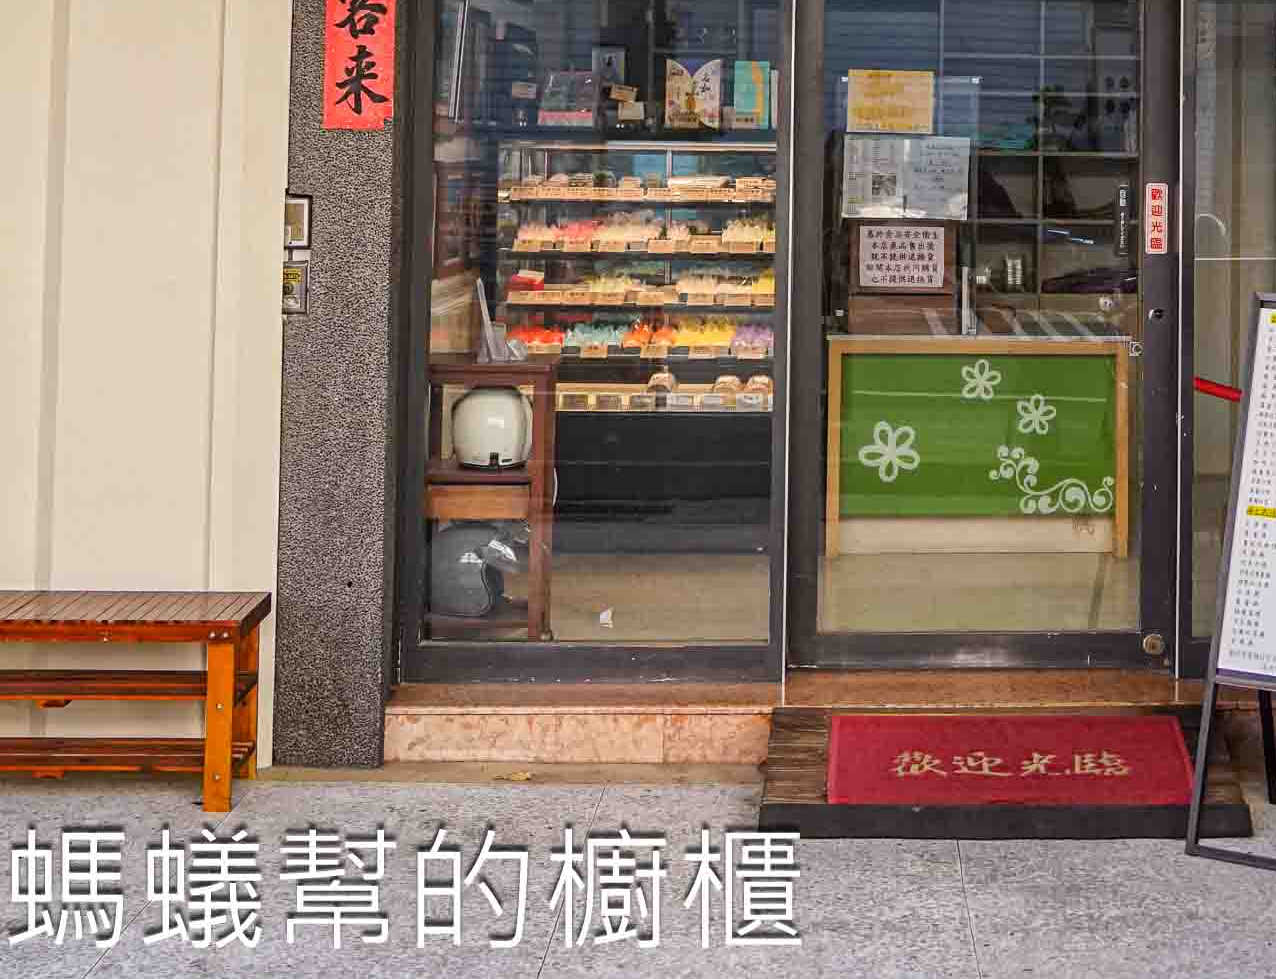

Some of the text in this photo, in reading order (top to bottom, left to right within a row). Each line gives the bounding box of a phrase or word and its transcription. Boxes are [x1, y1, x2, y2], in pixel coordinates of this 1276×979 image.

[1151, 188, 1163, 249] 歡迎光臨
[889, 751, 1132, 777] 歡迎光臨
